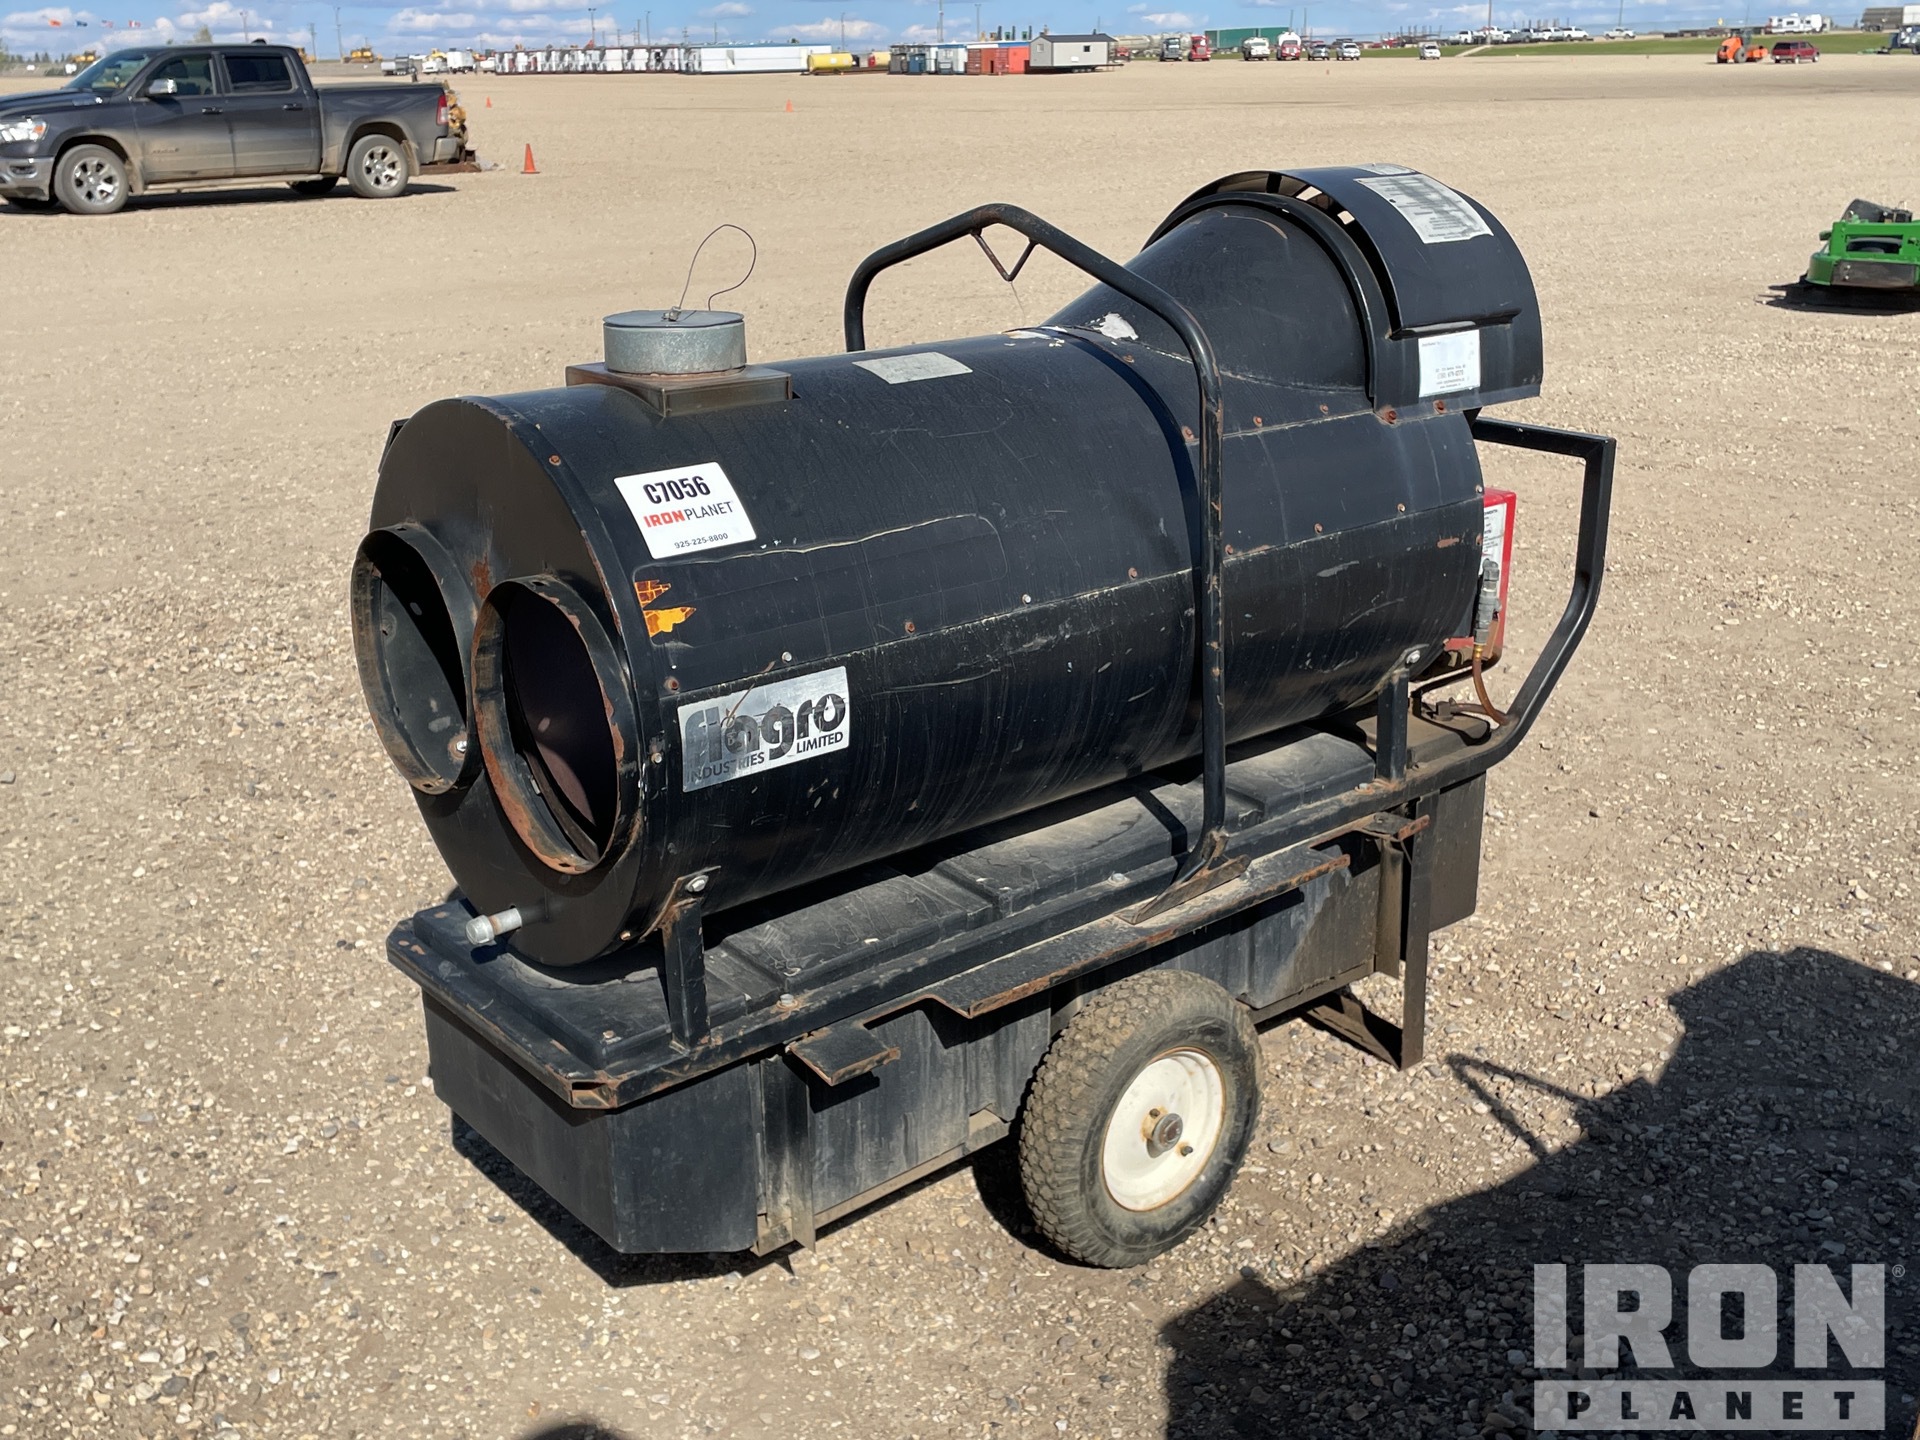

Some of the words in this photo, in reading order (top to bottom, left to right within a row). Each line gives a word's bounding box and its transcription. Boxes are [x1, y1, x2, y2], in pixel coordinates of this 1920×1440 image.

[643, 476, 711, 504] C7056
[674, 532, 729, 549] 925-225-8800
[685, 693, 847, 761] flagro
[796, 731, 844, 754] LIMITED
